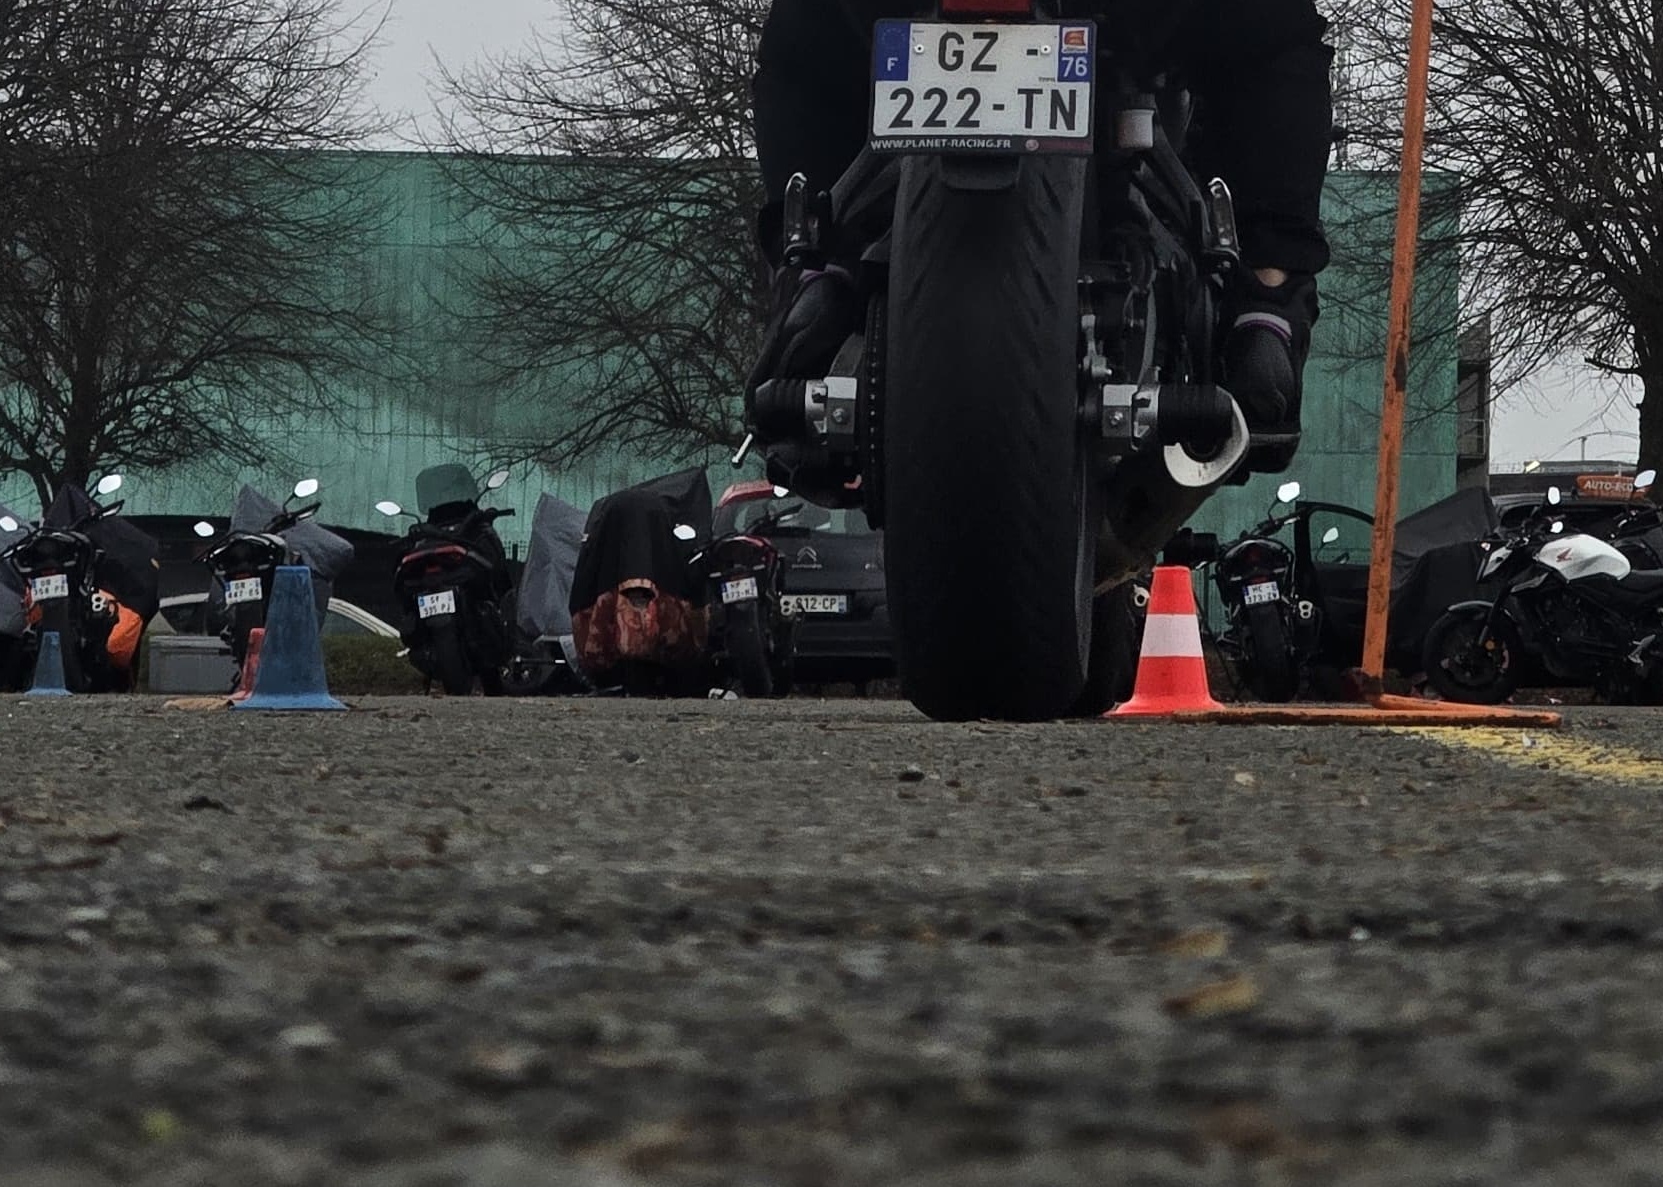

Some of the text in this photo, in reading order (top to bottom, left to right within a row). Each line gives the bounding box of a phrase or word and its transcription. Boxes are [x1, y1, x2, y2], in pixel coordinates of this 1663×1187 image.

[887, 57, 898, 72] F
[1061, 56, 1088, 78] 76
[870, 138, 1012, 151] WWW.PLANET-RACING.FR
[1583, 479, 1645, 493] AUTO-ECO
